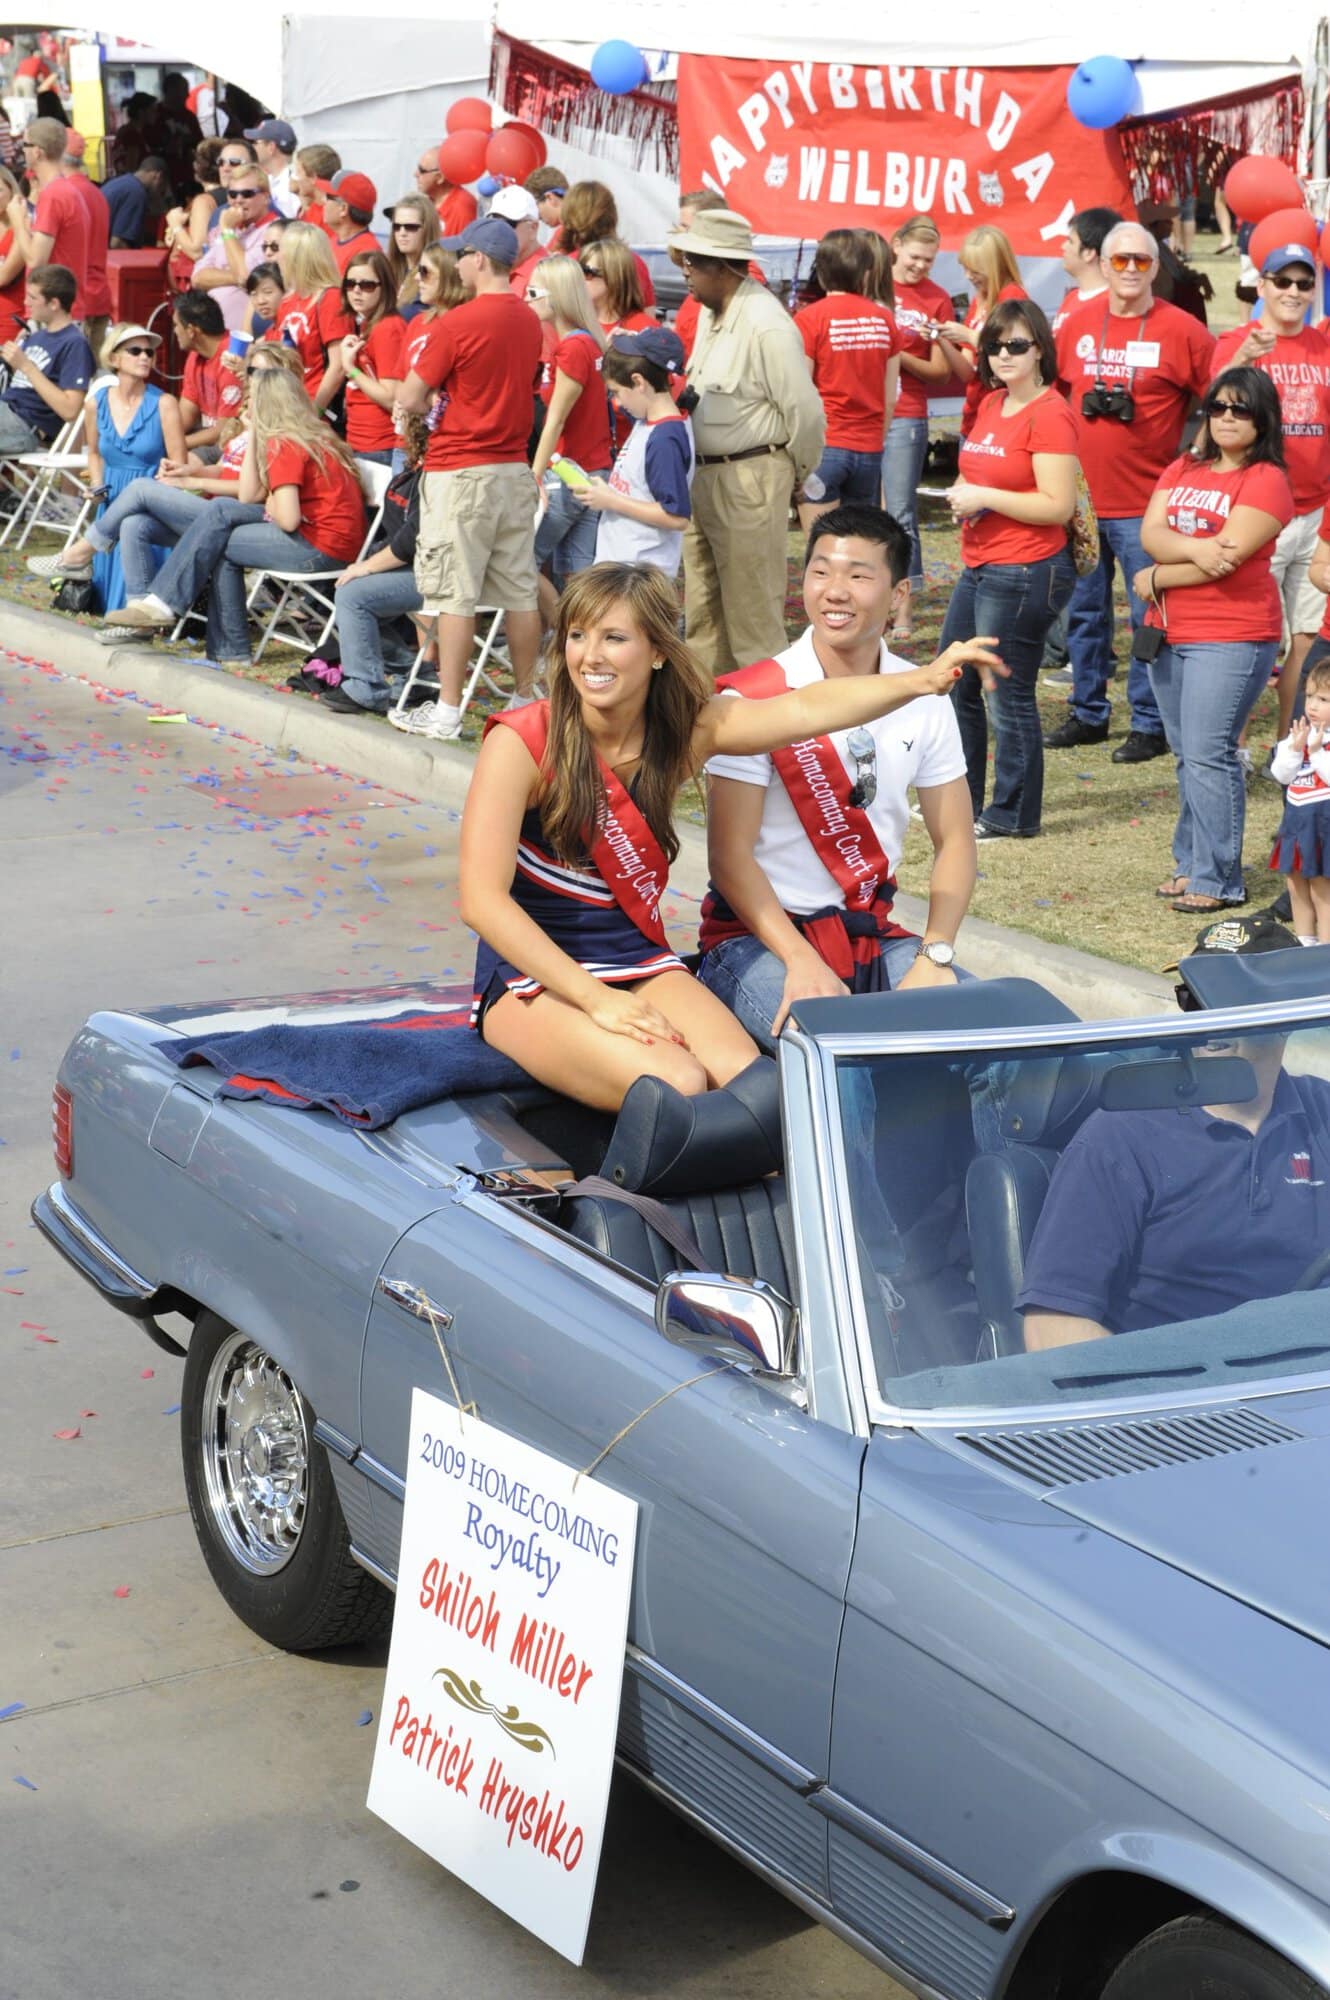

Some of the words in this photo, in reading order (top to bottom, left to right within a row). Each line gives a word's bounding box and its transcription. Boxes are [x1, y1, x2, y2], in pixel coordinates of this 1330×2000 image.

[1100, 348, 1126, 364] ARIZ
[1282, 424, 1325, 436] ILDCATS
[791, 738, 850, 836] Homecoming
[835, 834, 873, 877] Court
[420, 1433, 466, 1479] 2009
[468, 1458, 619, 1567] HOMECOMING
[463, 1501, 561, 1598] Royalty
[419, 1557, 501, 1653] Shiloh
[509, 1612, 593, 1705] Miller
[389, 1695, 474, 1797] Patrick
[479, 1757, 584, 1872] Hryshko
